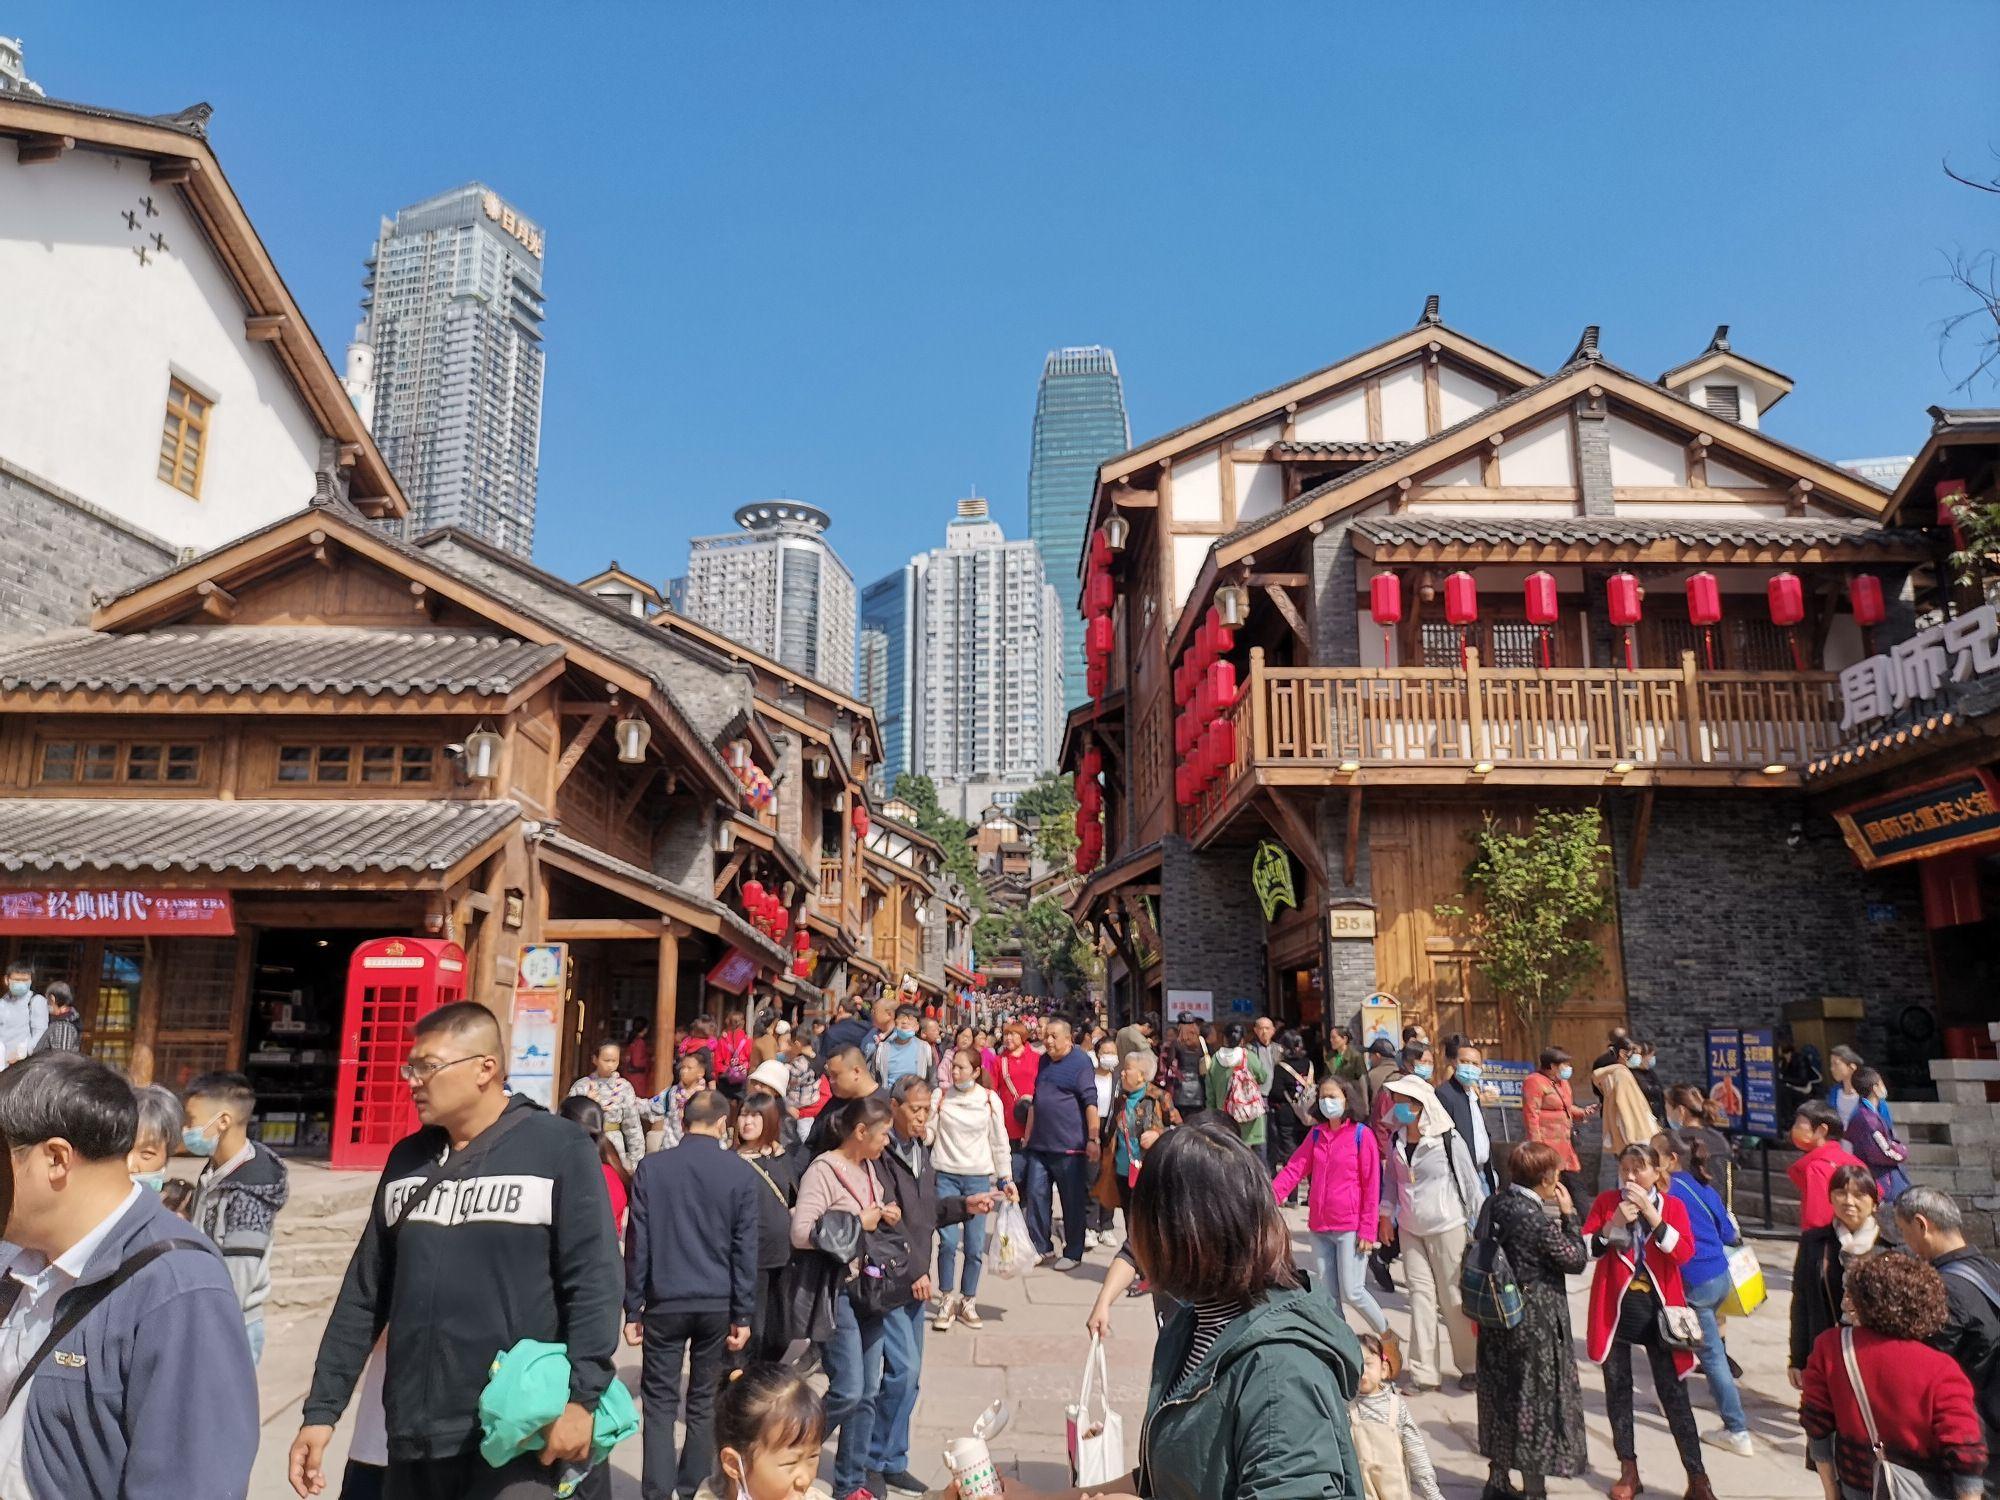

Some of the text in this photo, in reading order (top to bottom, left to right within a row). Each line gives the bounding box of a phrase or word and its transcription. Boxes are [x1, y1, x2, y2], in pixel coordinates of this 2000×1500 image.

[501, 206, 542, 259] 日月光
[1839, 604, 2000, 731] 周师兄
[47, 891, 147, 921] 经典时代
